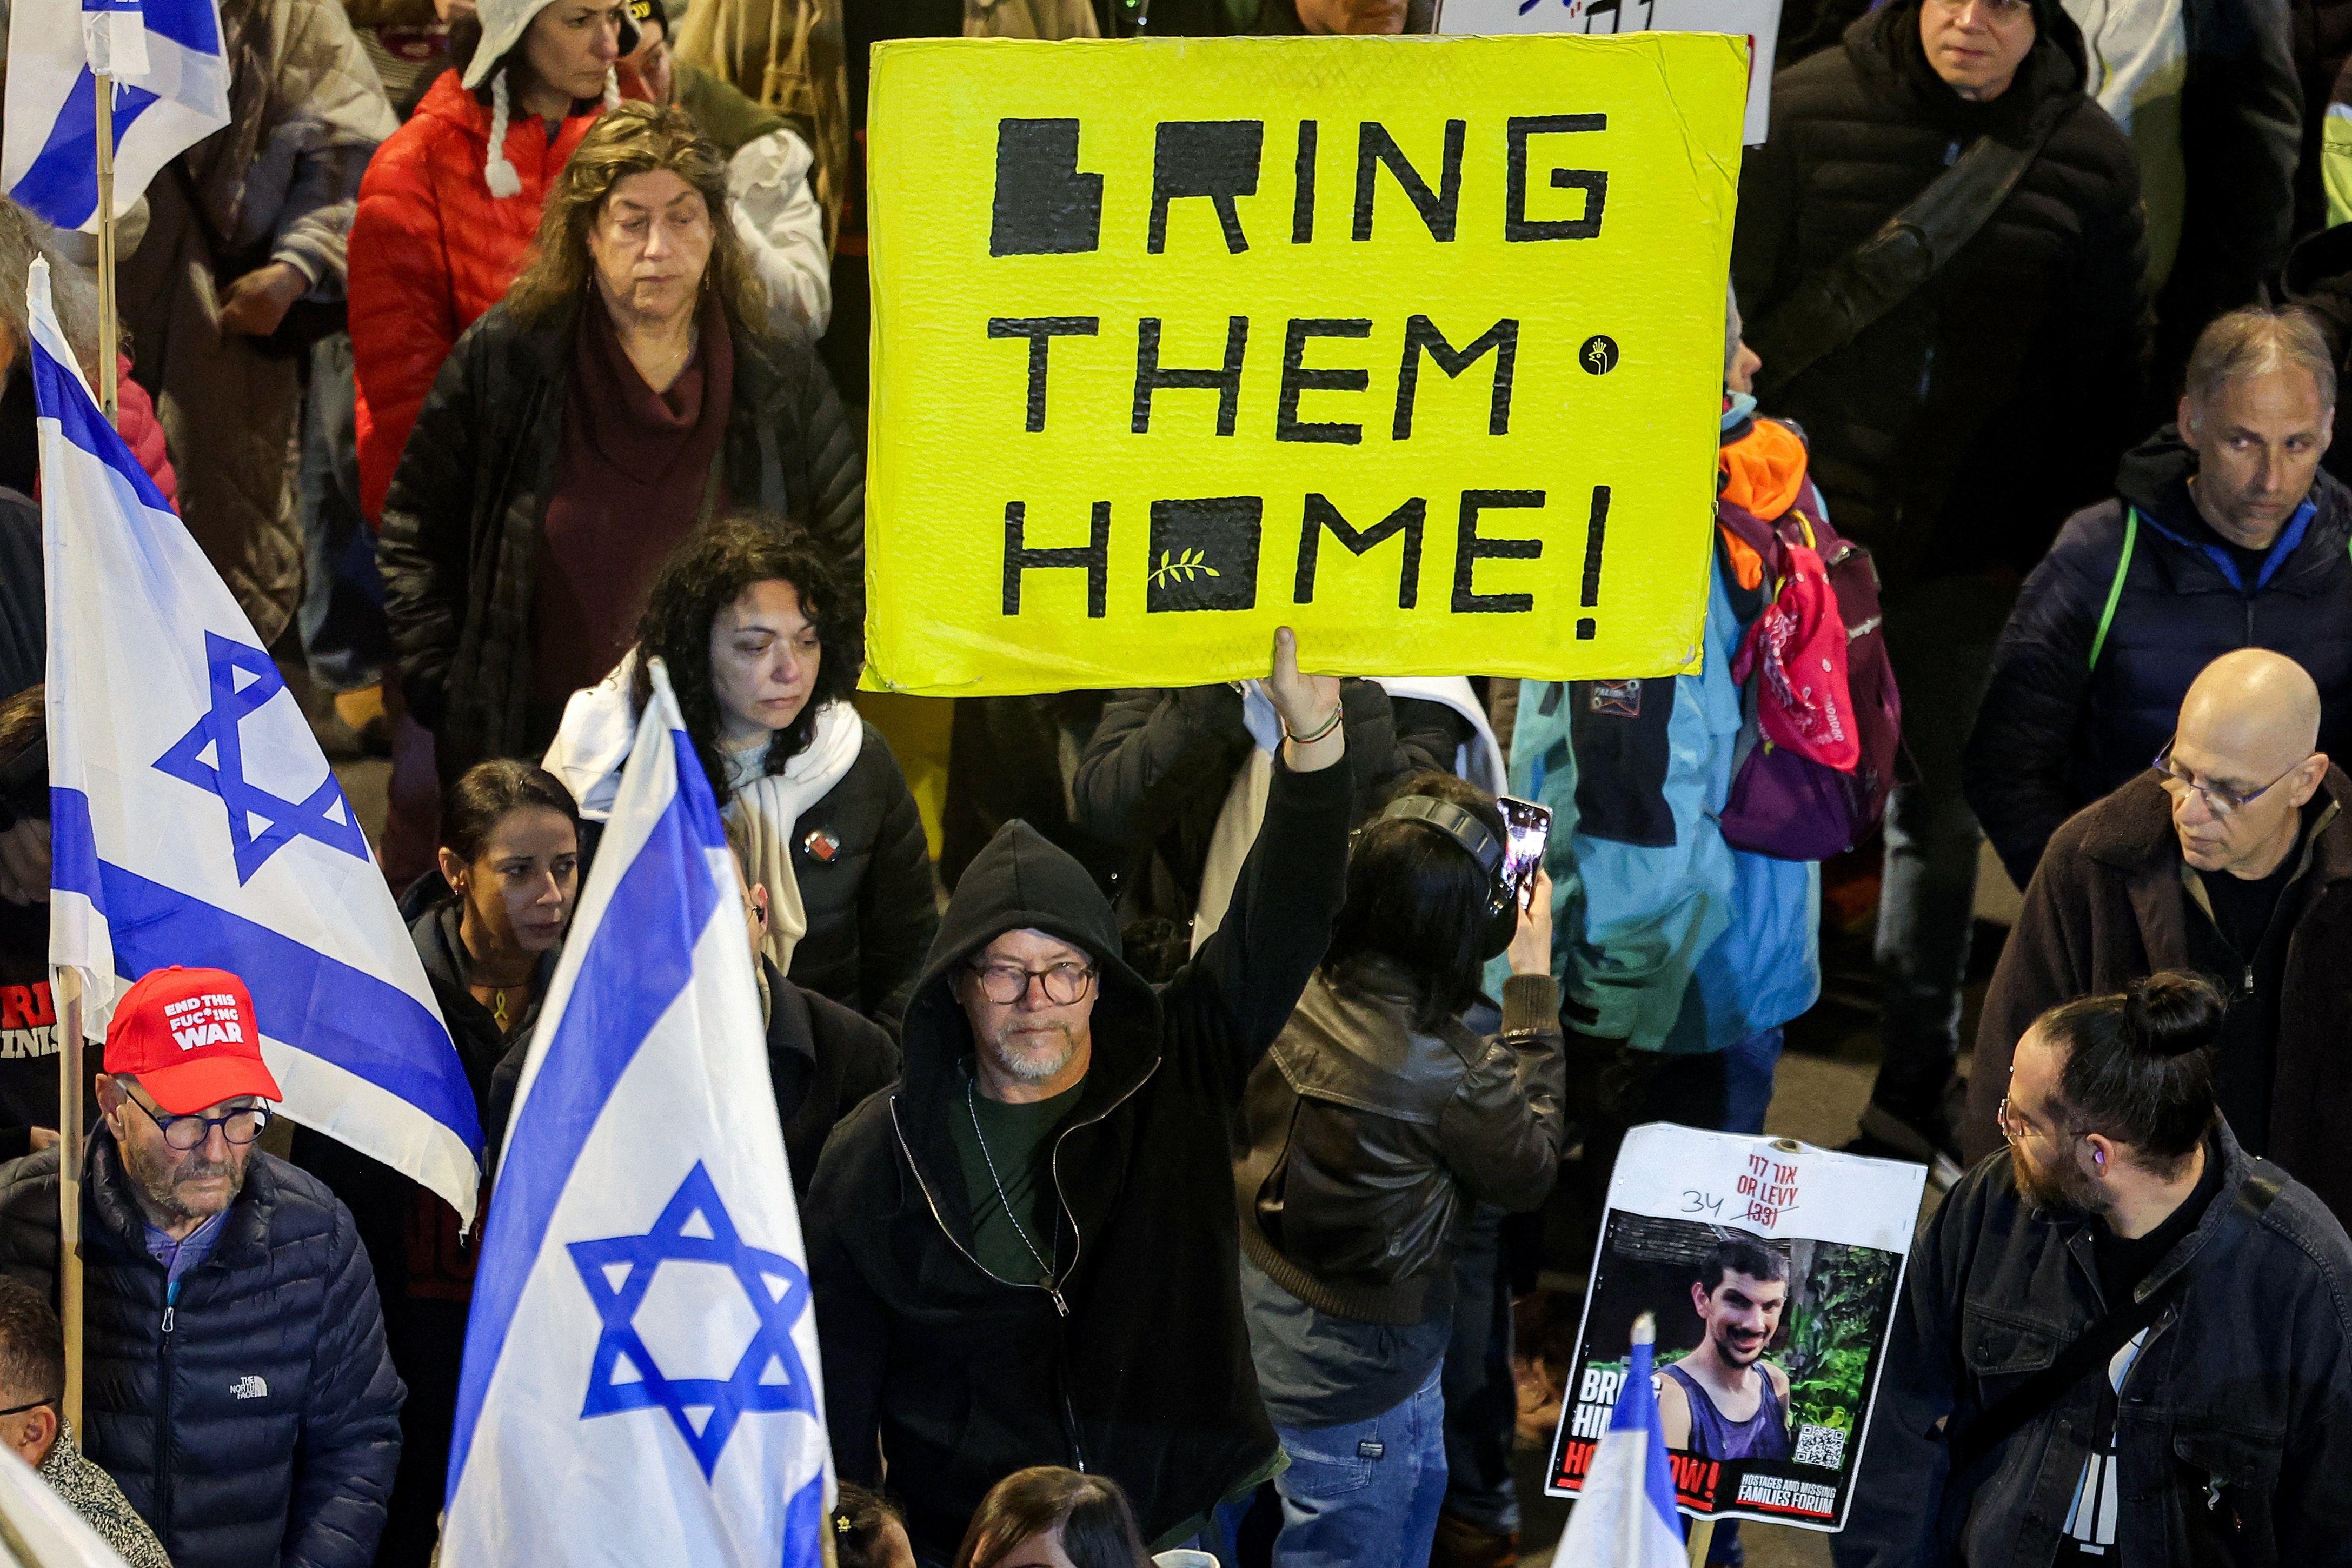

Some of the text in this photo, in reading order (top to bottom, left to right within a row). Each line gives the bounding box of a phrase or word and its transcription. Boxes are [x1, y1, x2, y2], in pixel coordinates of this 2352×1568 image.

[989, 114, 1607, 257] BRING
[988, 315, 1519, 445] THEM
[1002, 486, 1611, 640] HOME!
[164, 994, 236, 1017] END THIS
[172, 1022, 244, 1051] WAR
[1749, 1154, 1798, 1185] אור לוי
[1680, 1190, 1724, 1218] 34
[1737, 1175, 1799, 1206] OR LEVY
[230, 1383, 255, 1394] NORTH
[240, 1376, 254, 1385] THE
[237, 1391, 255, 1400] FACE
[1737, 1485, 1834, 1514] FAMILIES FORUM
[1742, 1474, 1836, 1498] HOSTAGES AND MISSING
